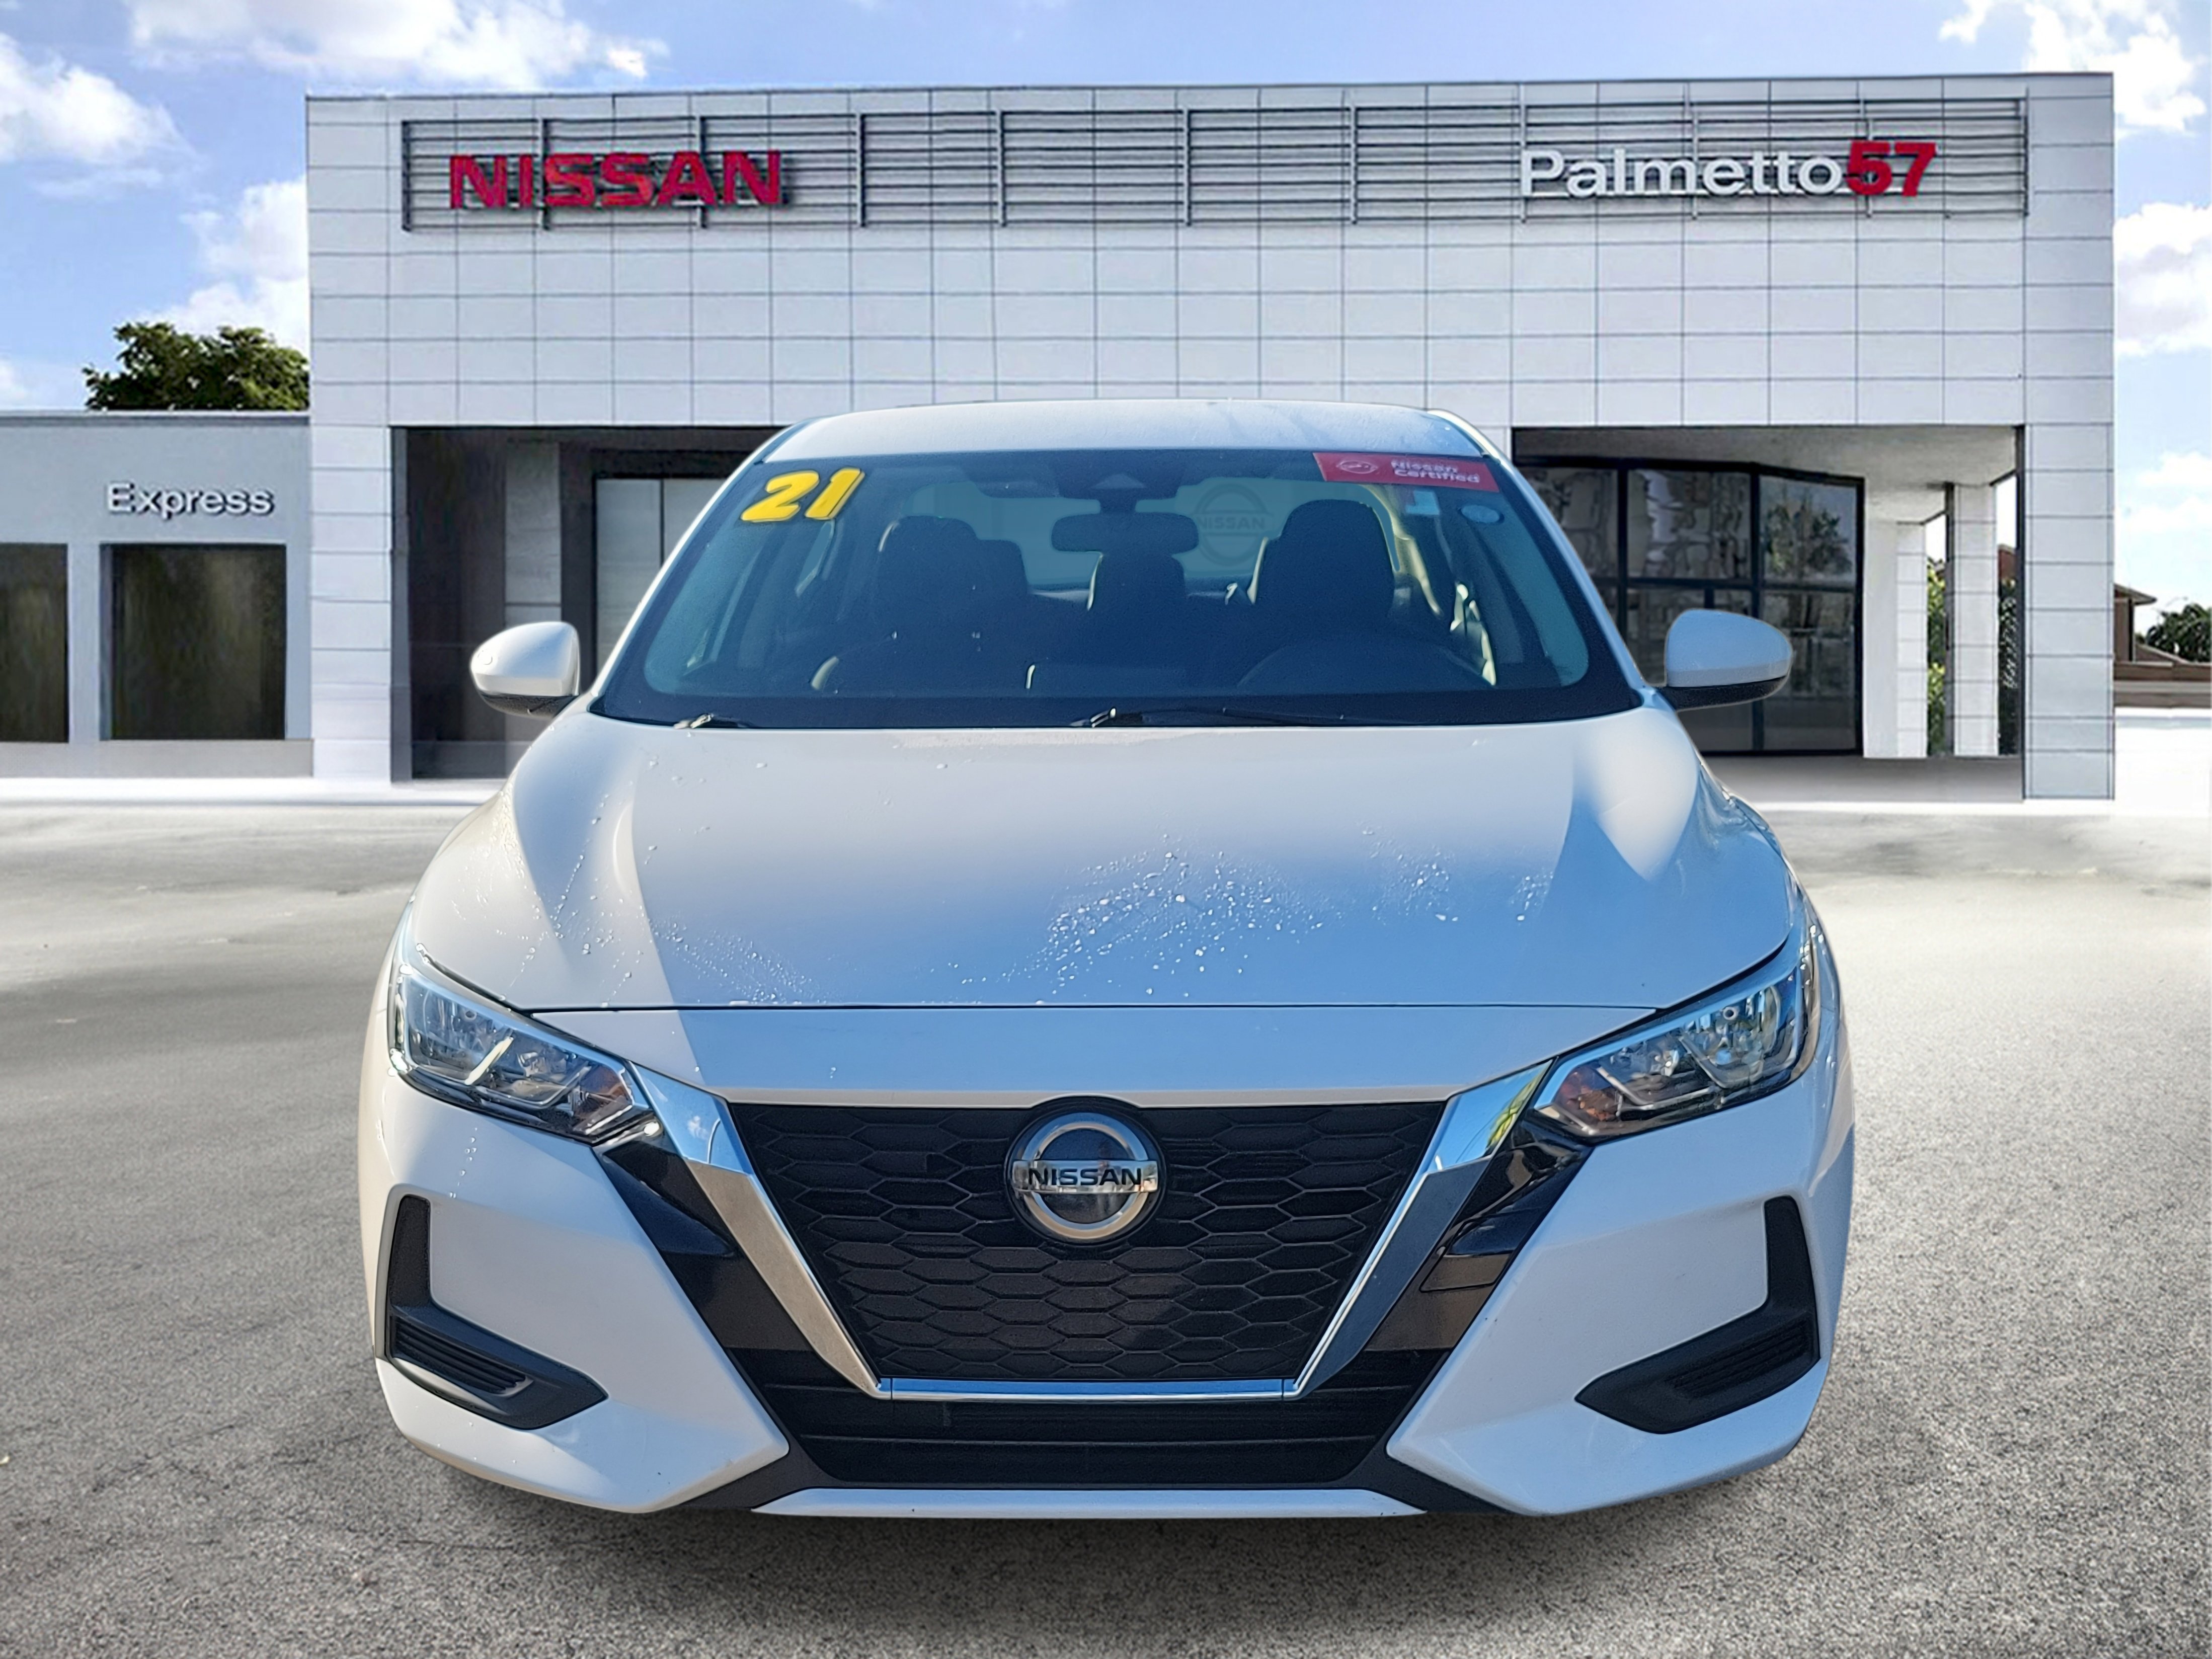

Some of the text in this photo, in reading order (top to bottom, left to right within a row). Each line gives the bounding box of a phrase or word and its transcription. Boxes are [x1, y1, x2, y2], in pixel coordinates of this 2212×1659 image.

[450, 149, 782, 208] NISSAN
[1390, 458, 1458, 473] Nissan
[1394, 468, 1480, 483] Certified
[107, 482, 274, 521] Express
[740, 467, 865, 523] 21
[1028, 1167, 1142, 1186] NISSAN
